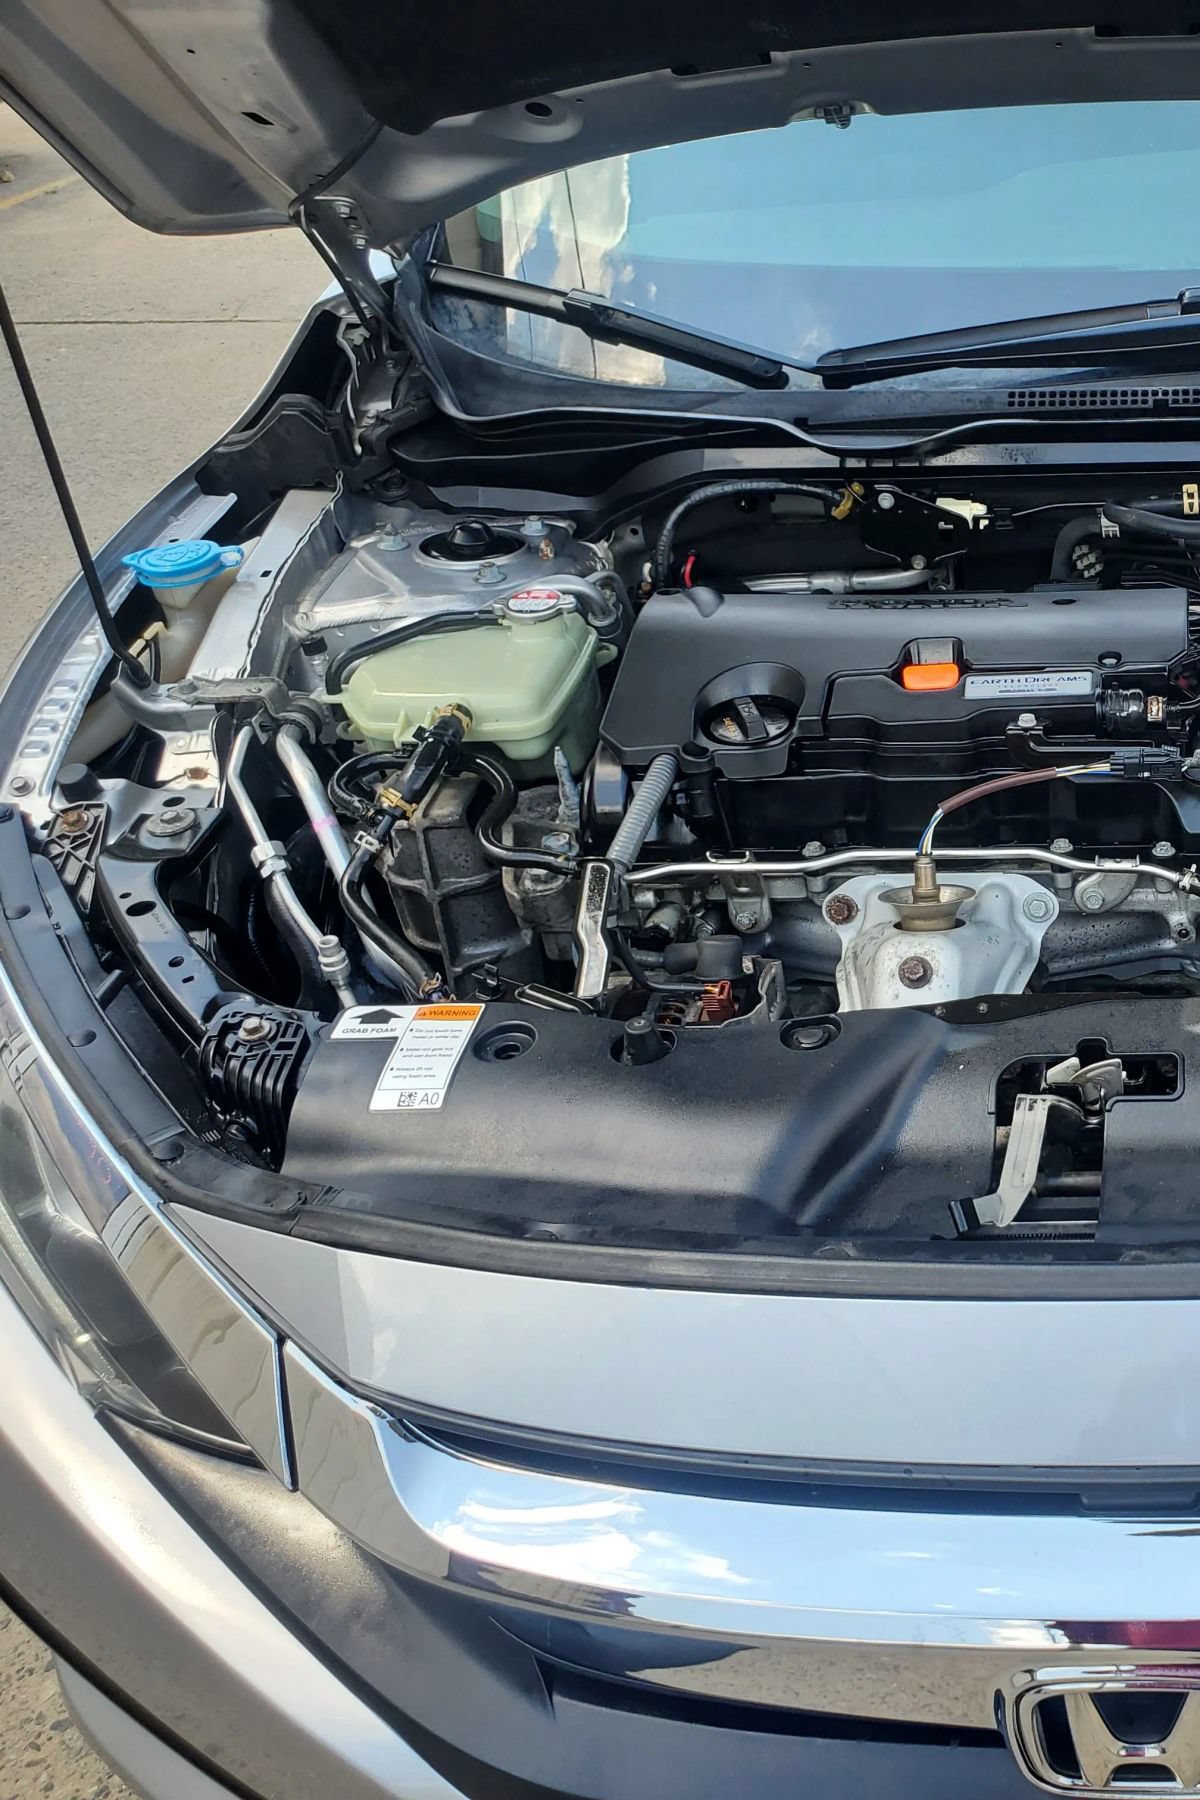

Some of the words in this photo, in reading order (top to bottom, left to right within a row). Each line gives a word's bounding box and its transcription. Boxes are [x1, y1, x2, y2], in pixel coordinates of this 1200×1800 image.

[826, 597, 1030, 610] HONDA
[970, 678, 1021, 686] EARTH
[429, 1009, 477, 1017] WARNING
[371, 1026, 398, 1034] FOAM
